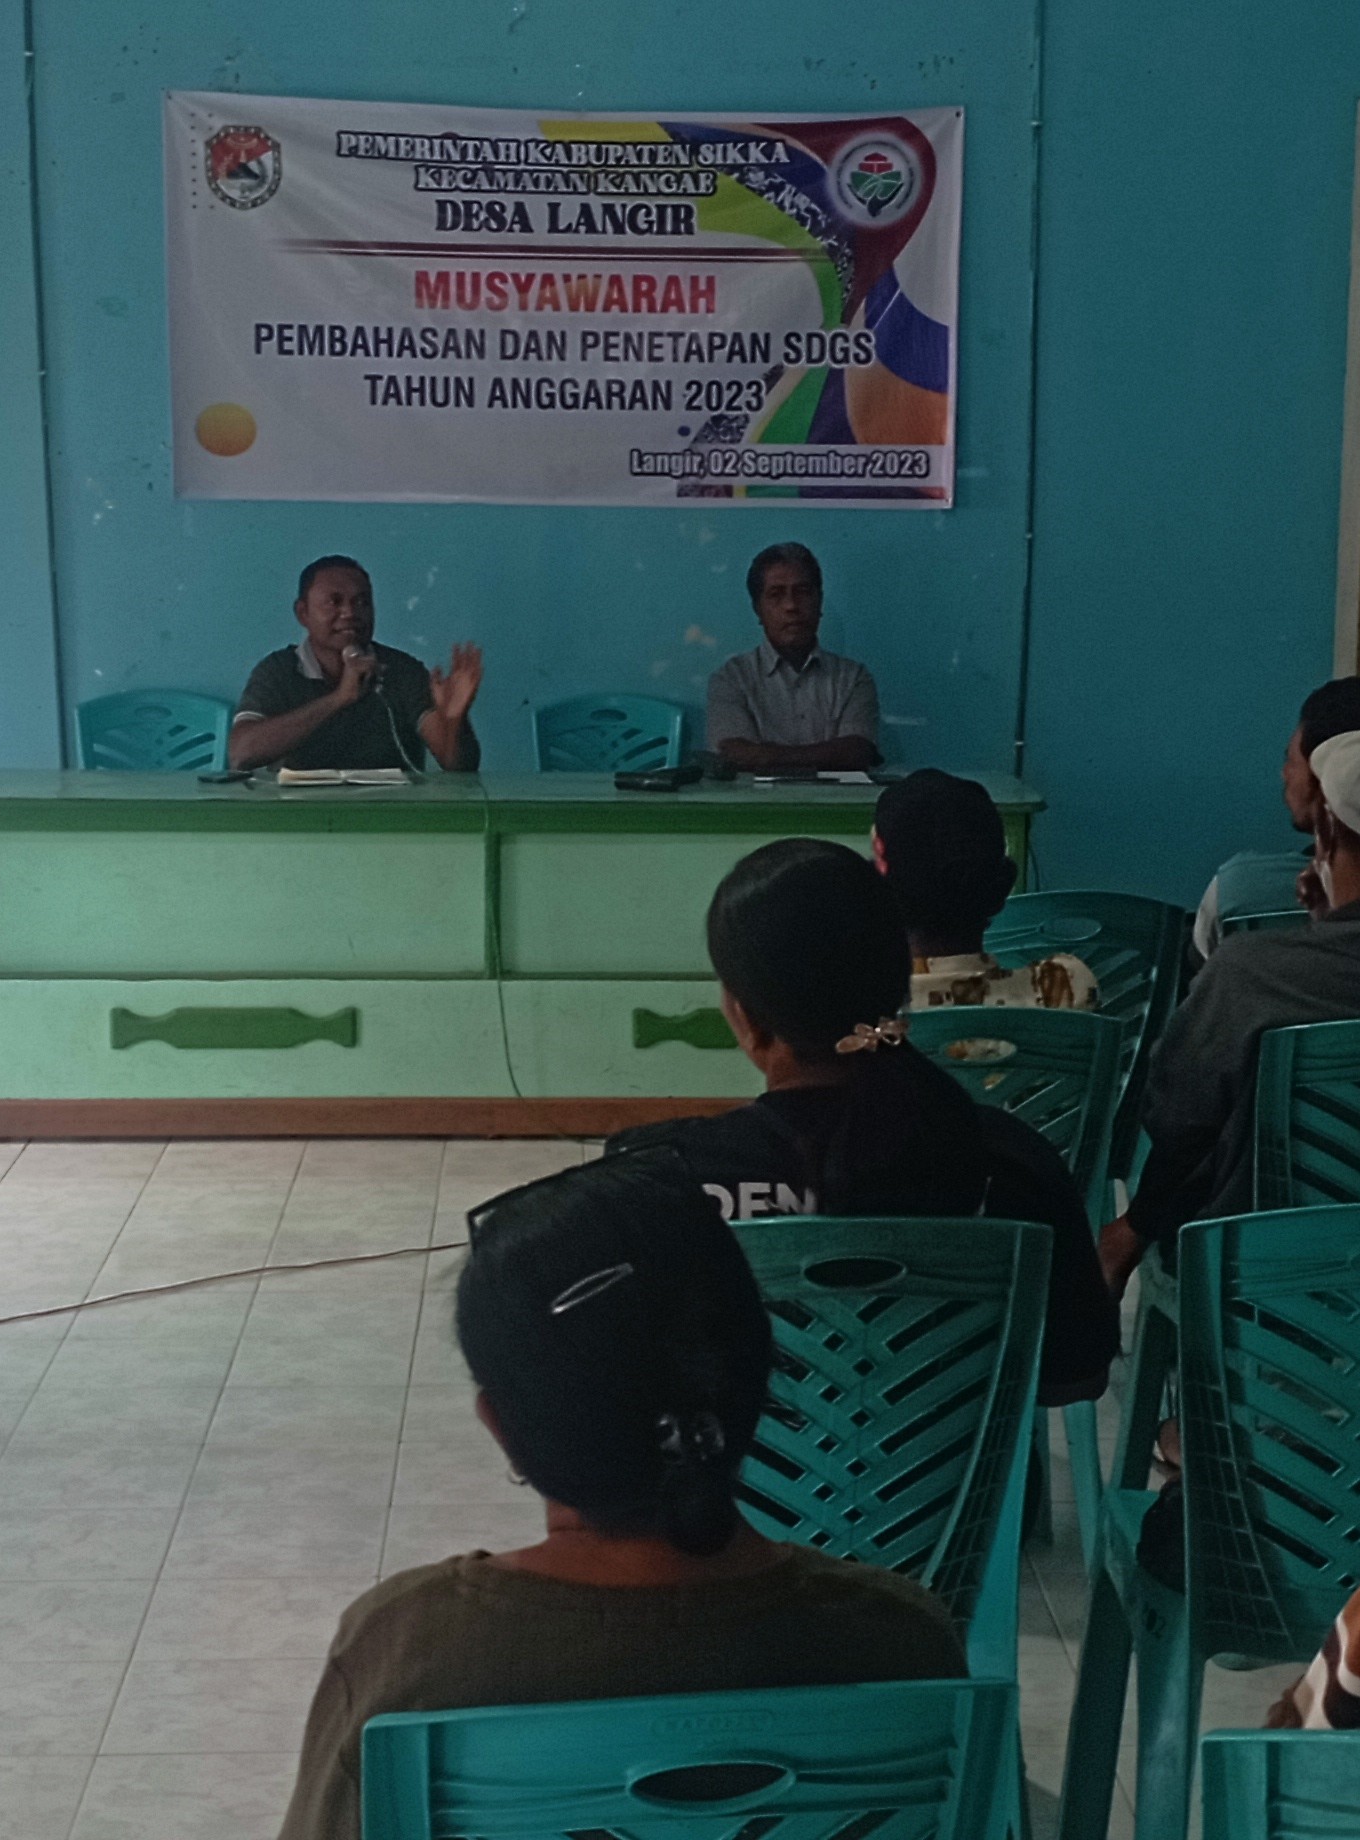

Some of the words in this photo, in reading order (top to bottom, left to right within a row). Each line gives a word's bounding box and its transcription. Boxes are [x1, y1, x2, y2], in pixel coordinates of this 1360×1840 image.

[337, 131, 521, 164] PEMERINTAH
[524, 140, 692, 166] KABUPATEN
[696, 139, 791, 166] SIKKA
[415, 165, 589, 193] KECAMATAN
[593, 170, 716, 195] KANGAE
[435, 199, 535, 233] DESA
[547, 201, 696, 236] LANGIR
[414, 270, 716, 314] MUSYAWARAH
[253, 322, 487, 361] PEMBAHASAN
[499, 328, 567, 362] DAN
[580, 329, 771, 365] PENETAPAN
[782, 330, 875, 367] SDGS
[363, 373, 475, 409] TAHUN
[487, 376, 672, 411] ANGGARAN
[684, 379, 765, 413] 2023
[630, 450, 705, 478] Langir,
[708, 450, 737, 475] 02
[741, 450, 868, 479] September
[871, 452, 929, 478] 2023
